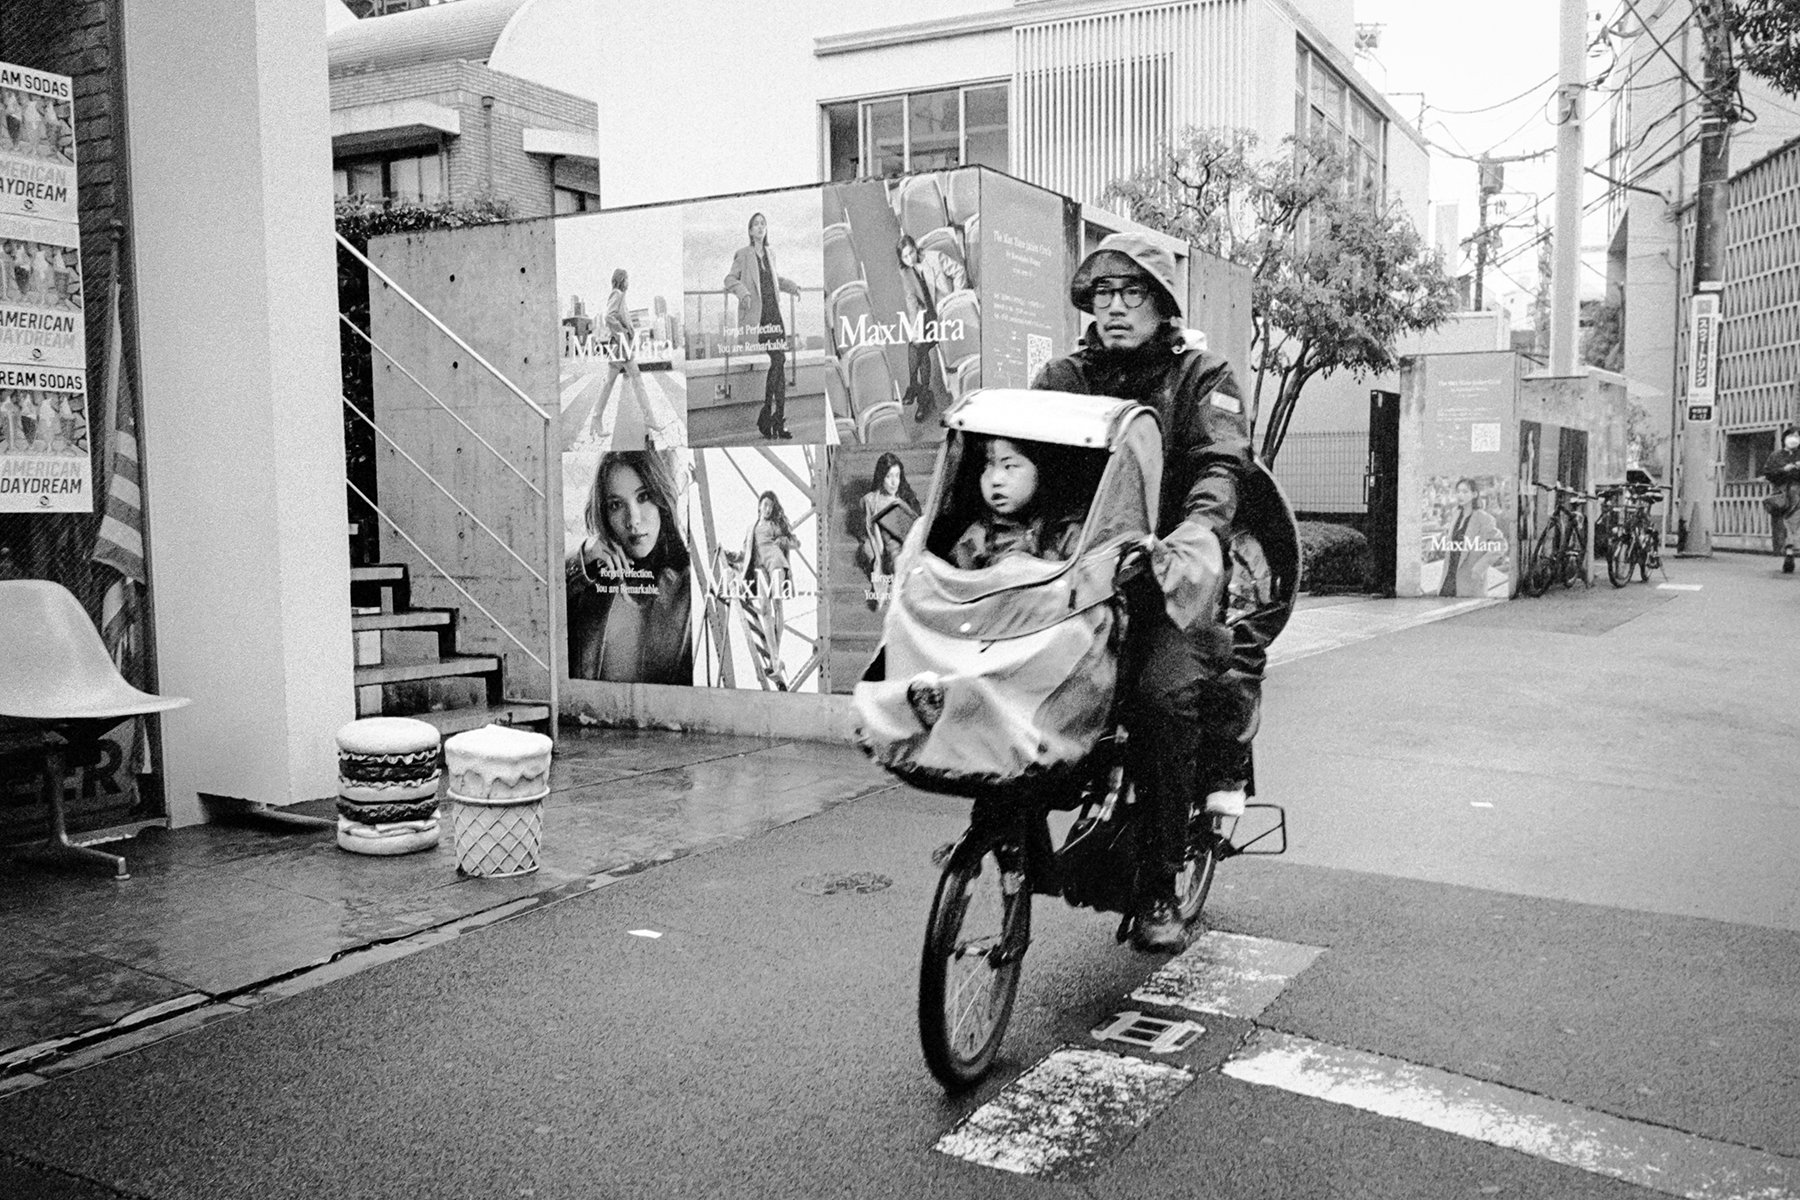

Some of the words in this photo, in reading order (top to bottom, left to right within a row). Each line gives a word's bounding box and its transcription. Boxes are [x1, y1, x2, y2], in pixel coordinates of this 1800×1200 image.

[25, 74, 69, 97] SODAS
[746, 323, 783, 336] Perfection,
[839, 309, 965, 348] MaxMara
[572, 330, 675, 362] MaxMara
[718, 343, 731, 354] You
[732, 345, 743, 353] are
[0, 370, 35, 386] REAM
[39, 373, 83, 390] SODAS
[2, 460, 80, 478] AMERICAN
[1, 477, 83, 494] DAYDREAM
[1430, 535, 1502, 552] MaxMara
[621, 567, 655, 580] Perfection,
[595, 583, 607, 593] You
[609, 585, 619, 594] are
[704, 568, 817, 600] MaxMa
